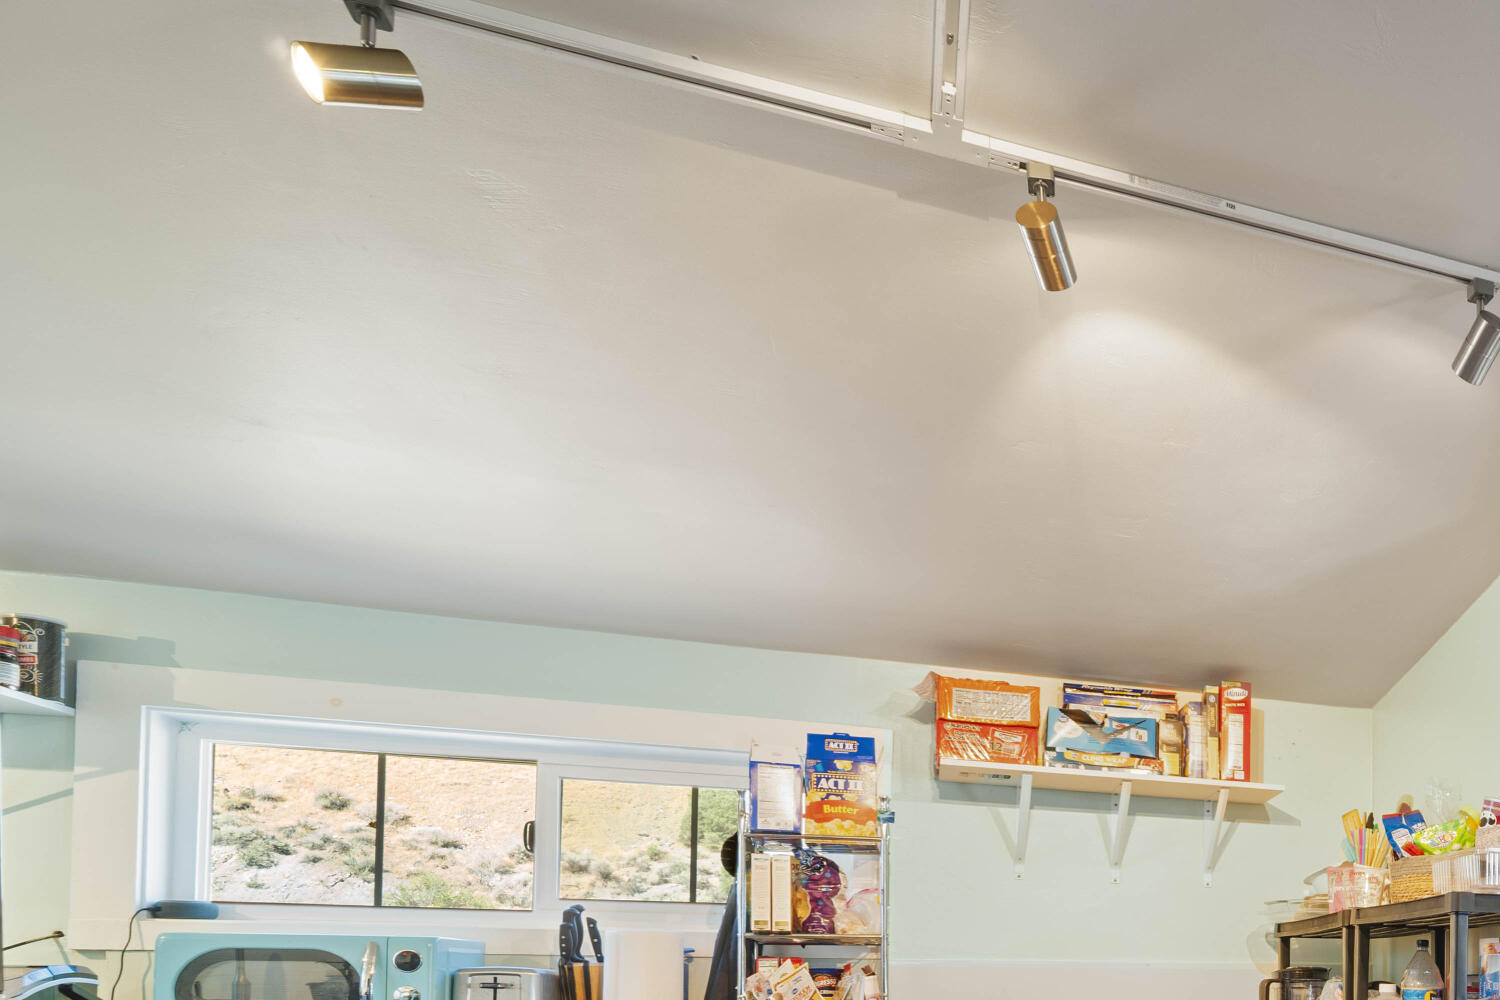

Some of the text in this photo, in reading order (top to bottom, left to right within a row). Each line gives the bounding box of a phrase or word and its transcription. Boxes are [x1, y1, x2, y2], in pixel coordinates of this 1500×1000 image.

[817, 778, 864, 791] ACT II
[823, 804, 857, 815] Butter
